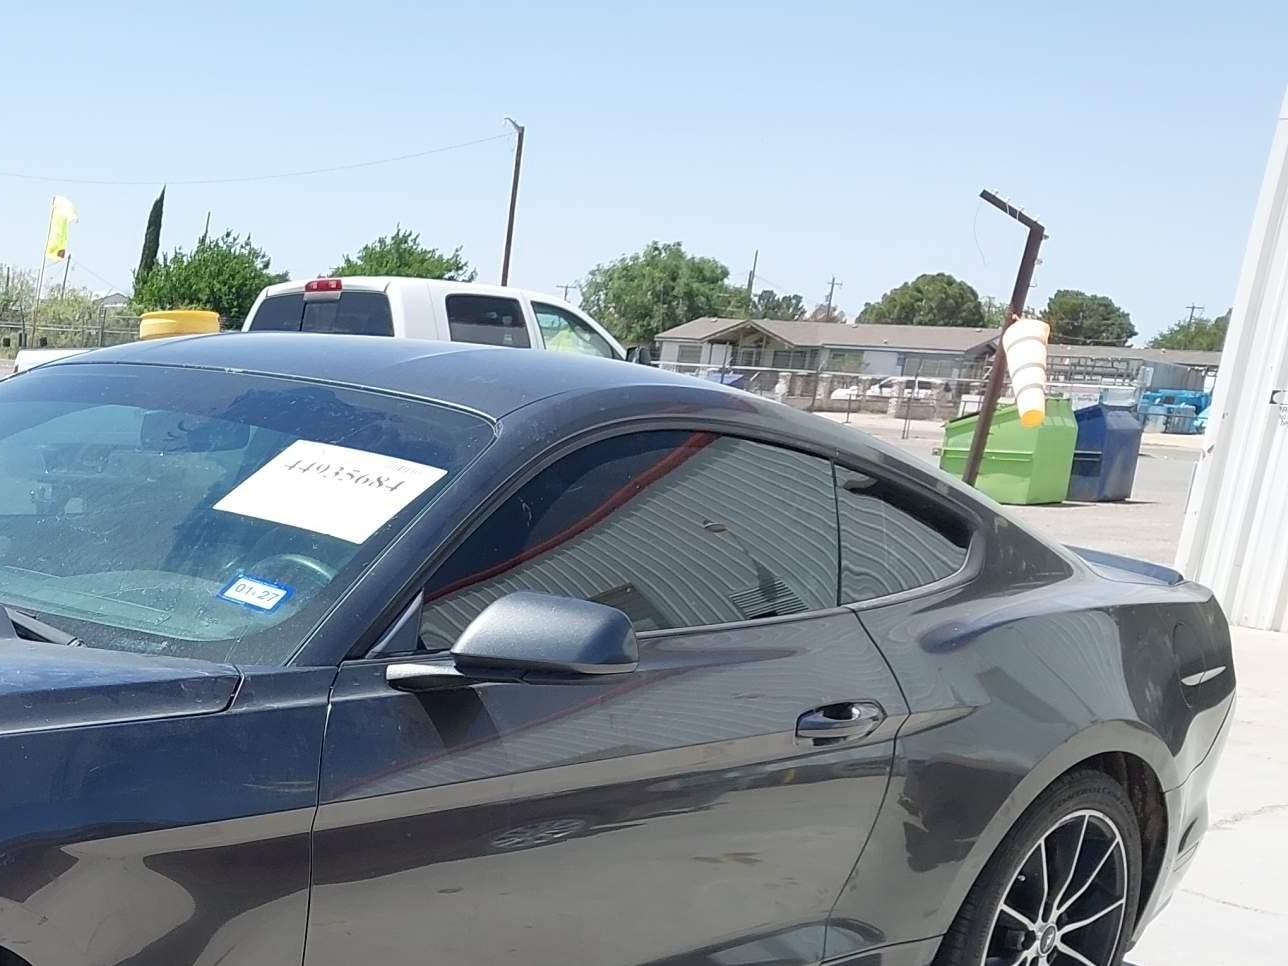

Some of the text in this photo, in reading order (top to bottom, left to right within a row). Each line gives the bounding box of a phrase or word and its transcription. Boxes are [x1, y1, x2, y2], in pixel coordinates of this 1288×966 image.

[284, 460, 406, 492] 44935684
[235, 583, 280, 602] 01 27
